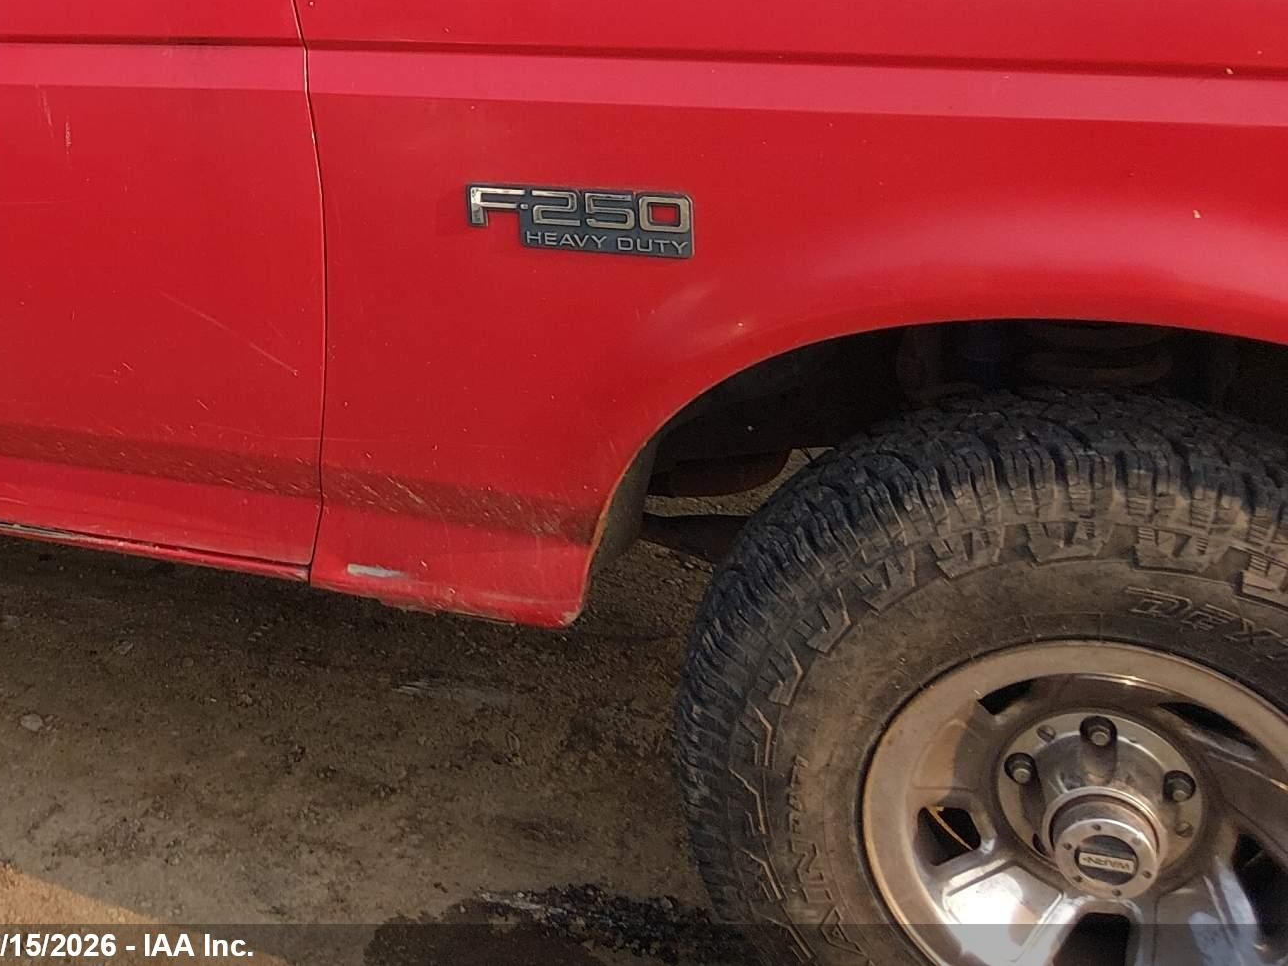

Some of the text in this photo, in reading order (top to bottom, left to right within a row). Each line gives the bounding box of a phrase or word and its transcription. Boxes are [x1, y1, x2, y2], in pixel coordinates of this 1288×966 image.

[468, 186, 692, 233] F-250
[525, 230, 690, 255] HEAVY DUTY
